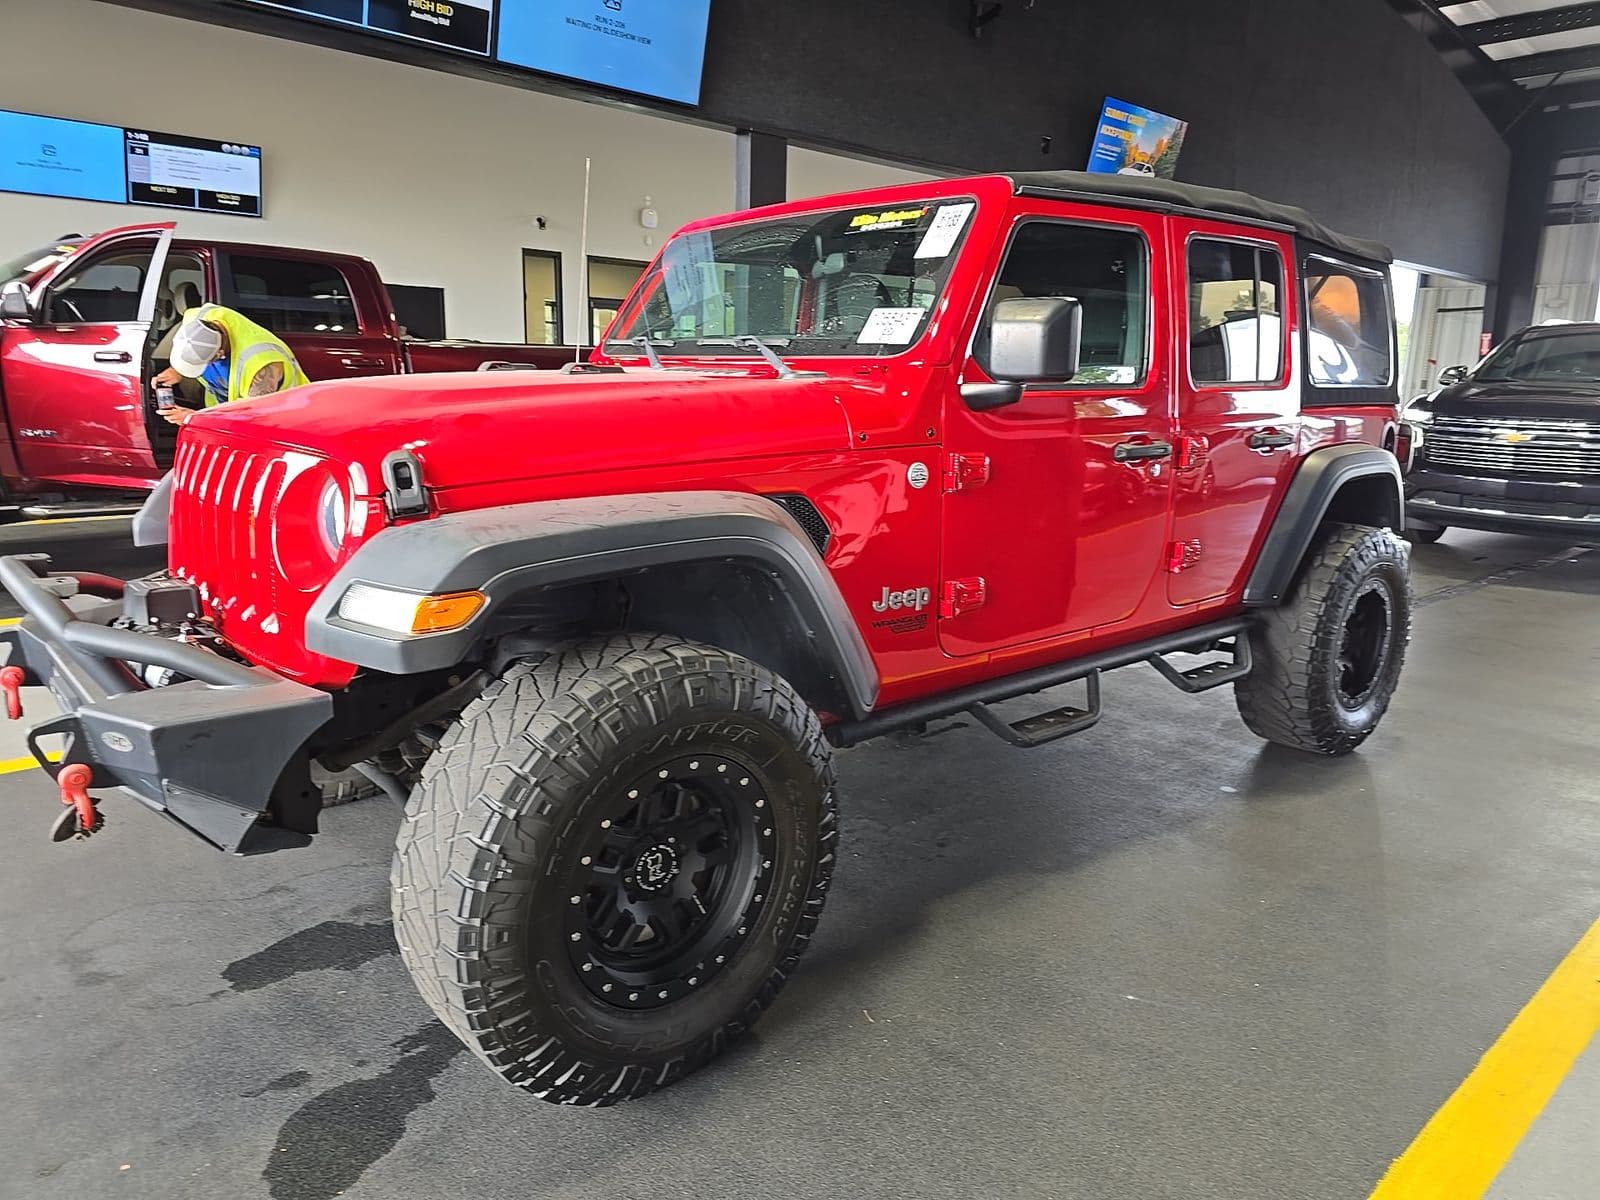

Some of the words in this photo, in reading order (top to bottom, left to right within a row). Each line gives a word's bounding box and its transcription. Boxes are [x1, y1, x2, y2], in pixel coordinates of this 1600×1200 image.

[407, 0, 435, 12] HIGH
[436, 2, 454, 17] BID
[872, 586, 930, 612] Jeep
